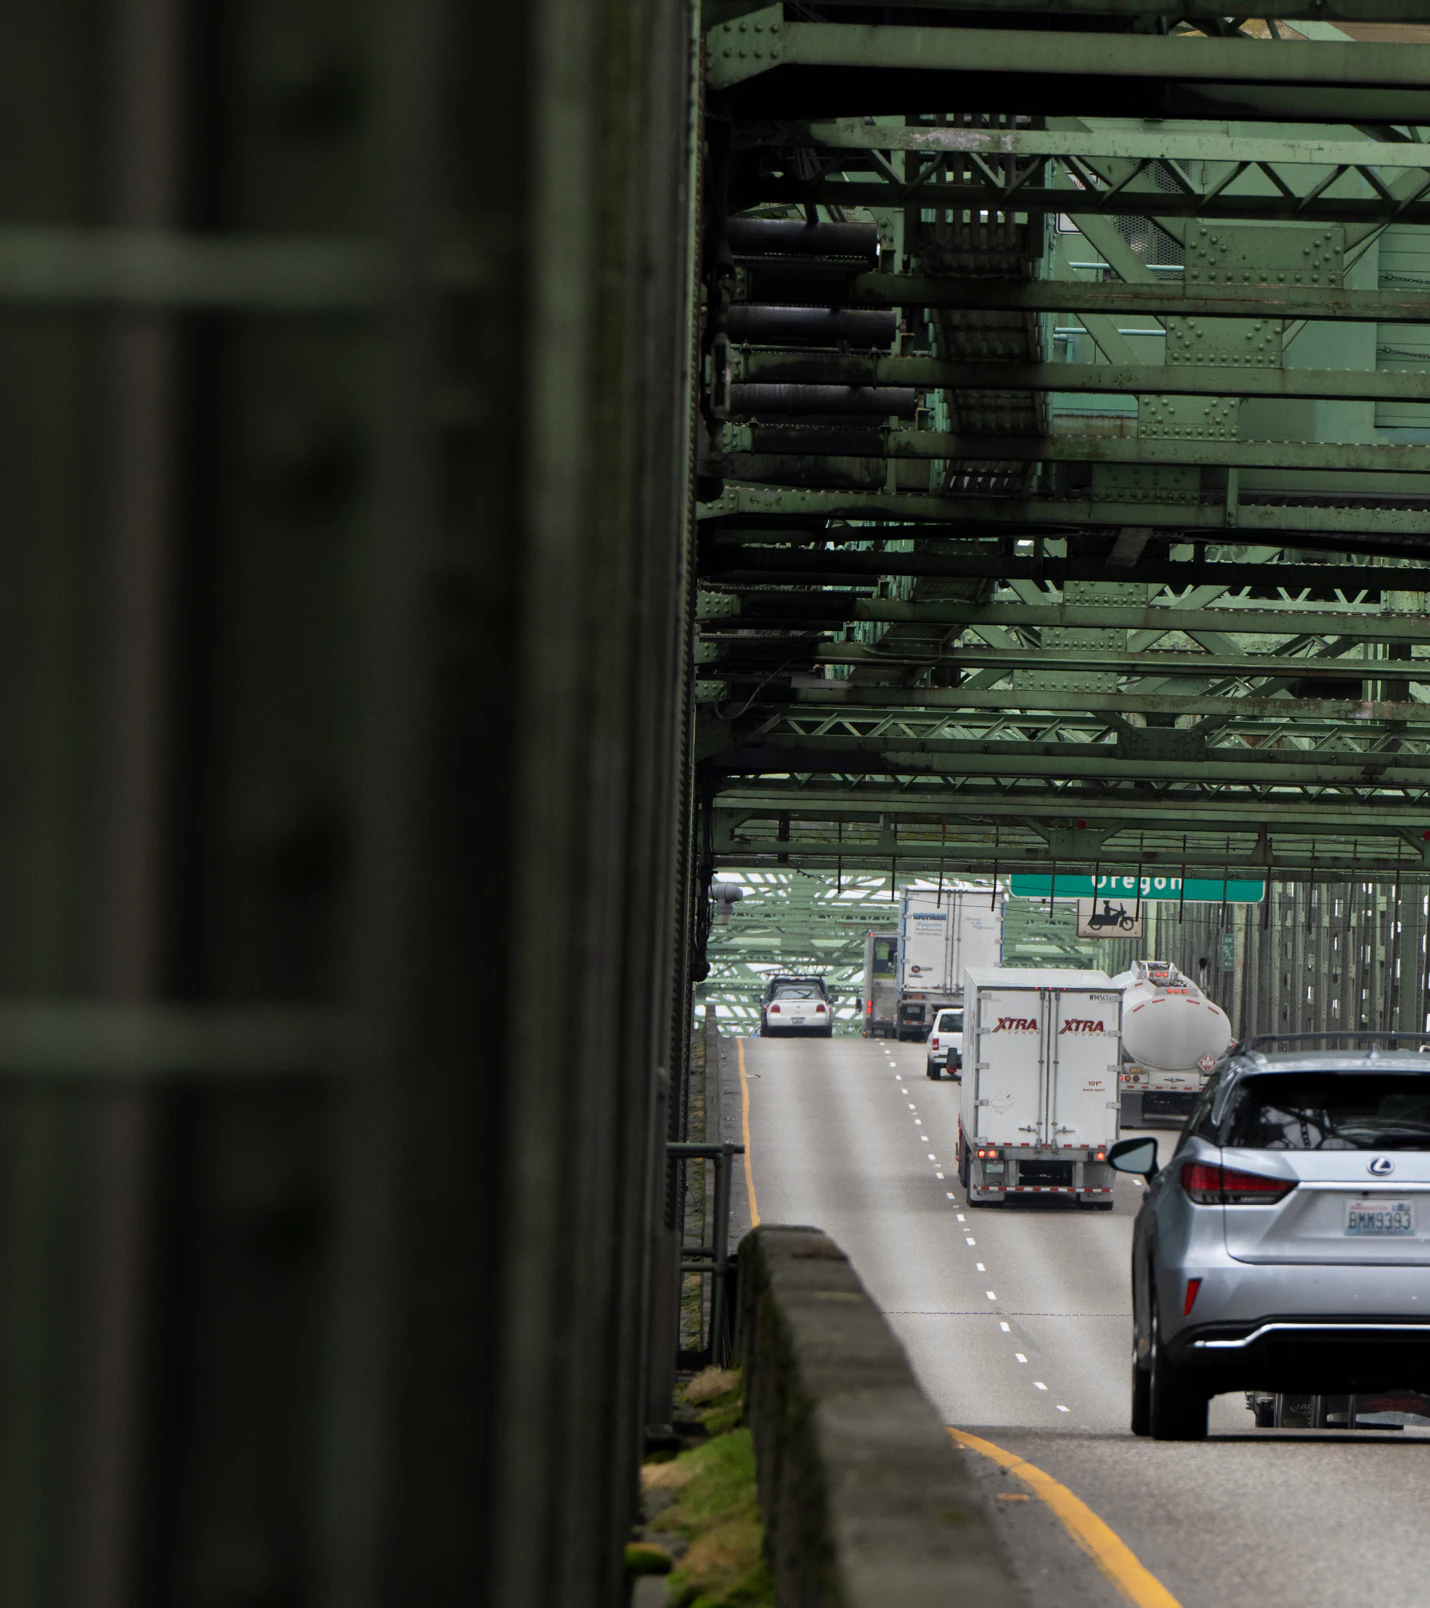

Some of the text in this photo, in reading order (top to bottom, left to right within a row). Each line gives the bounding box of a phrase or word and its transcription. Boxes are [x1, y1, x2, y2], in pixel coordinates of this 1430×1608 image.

[1091, 875, 1183, 896] Oregon
[992, 1017, 1039, 1033] XTRA
[1058, 1018, 1105, 1035] XTRA
[1348, 1211, 1412, 1230] BMM9393
